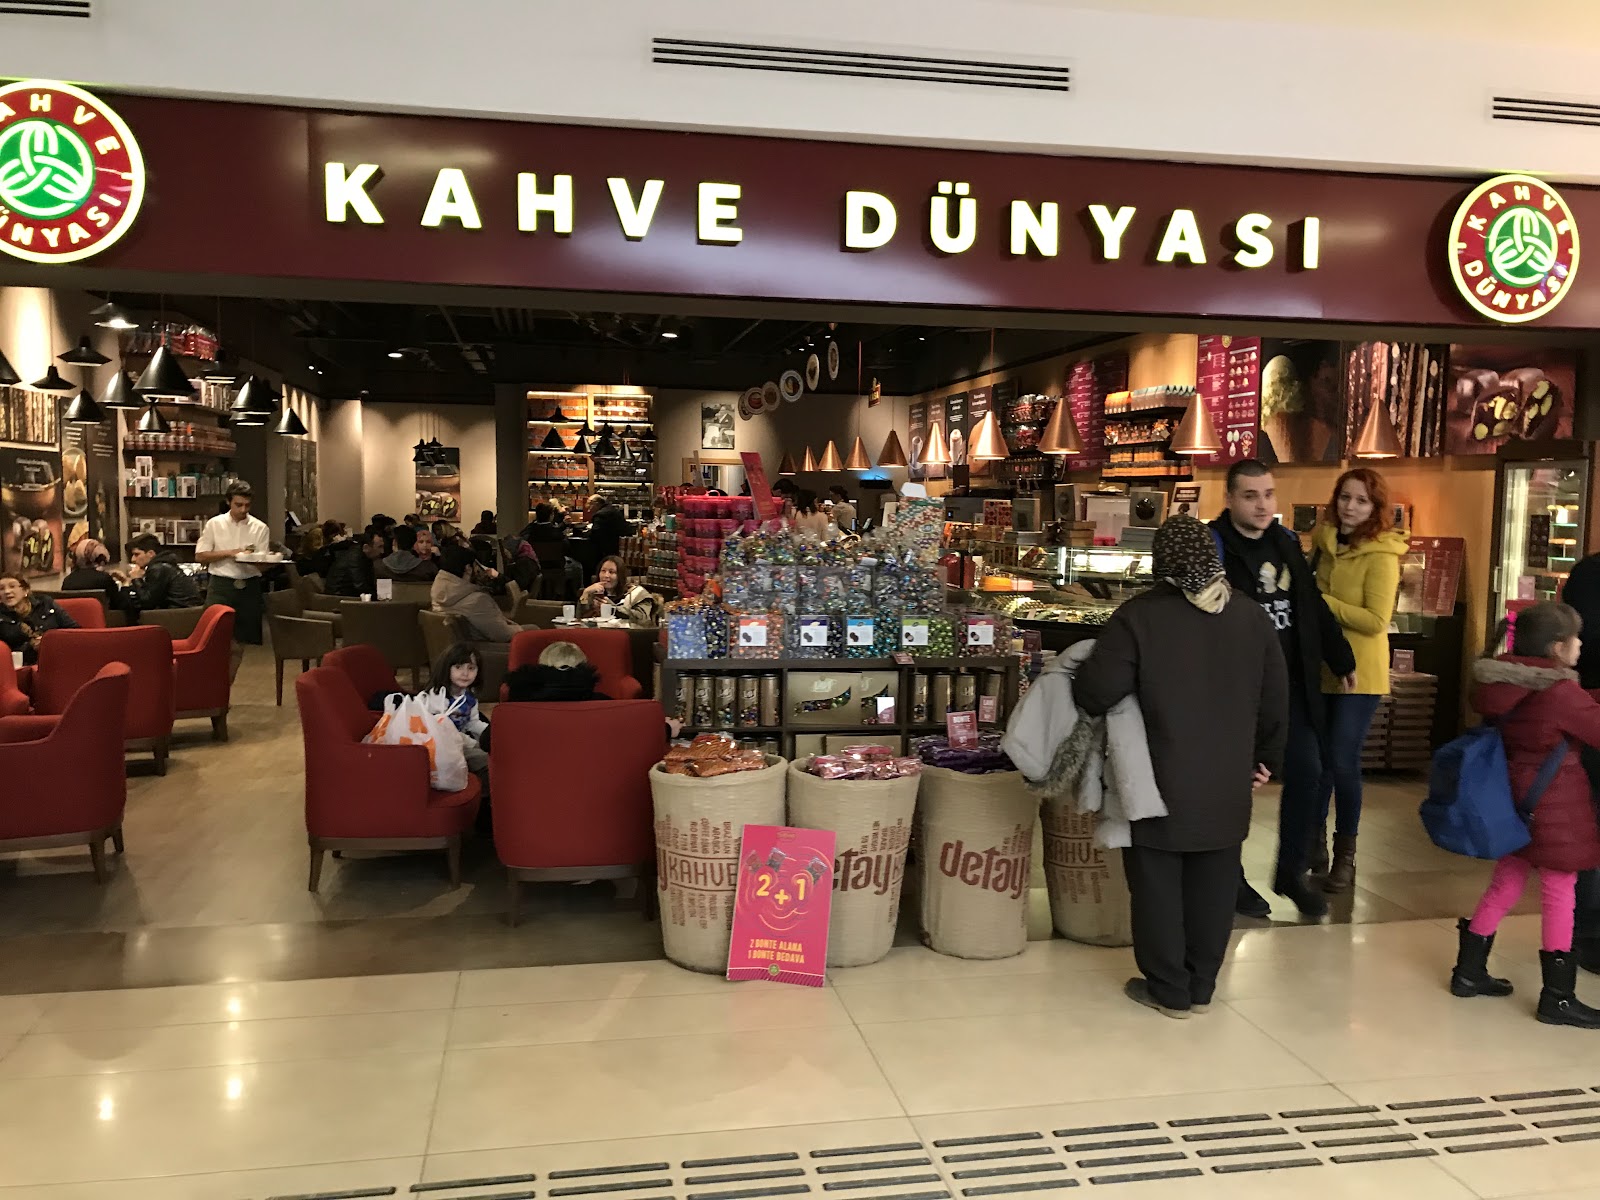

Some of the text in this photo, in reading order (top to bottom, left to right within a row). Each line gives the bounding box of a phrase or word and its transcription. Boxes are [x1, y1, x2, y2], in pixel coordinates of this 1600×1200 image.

[0, 93, 121, 155] AHVE
[0, 193, 122, 248] NYASI
[325, 161, 1320, 269] KAHVE DÜNYASI
[1467, 185, 1571, 235] KAHVE
[1465, 260, 1568, 310] DÜNYASI
[939, 840, 1026, 900] detay
[750, 939, 755, 949] 2
